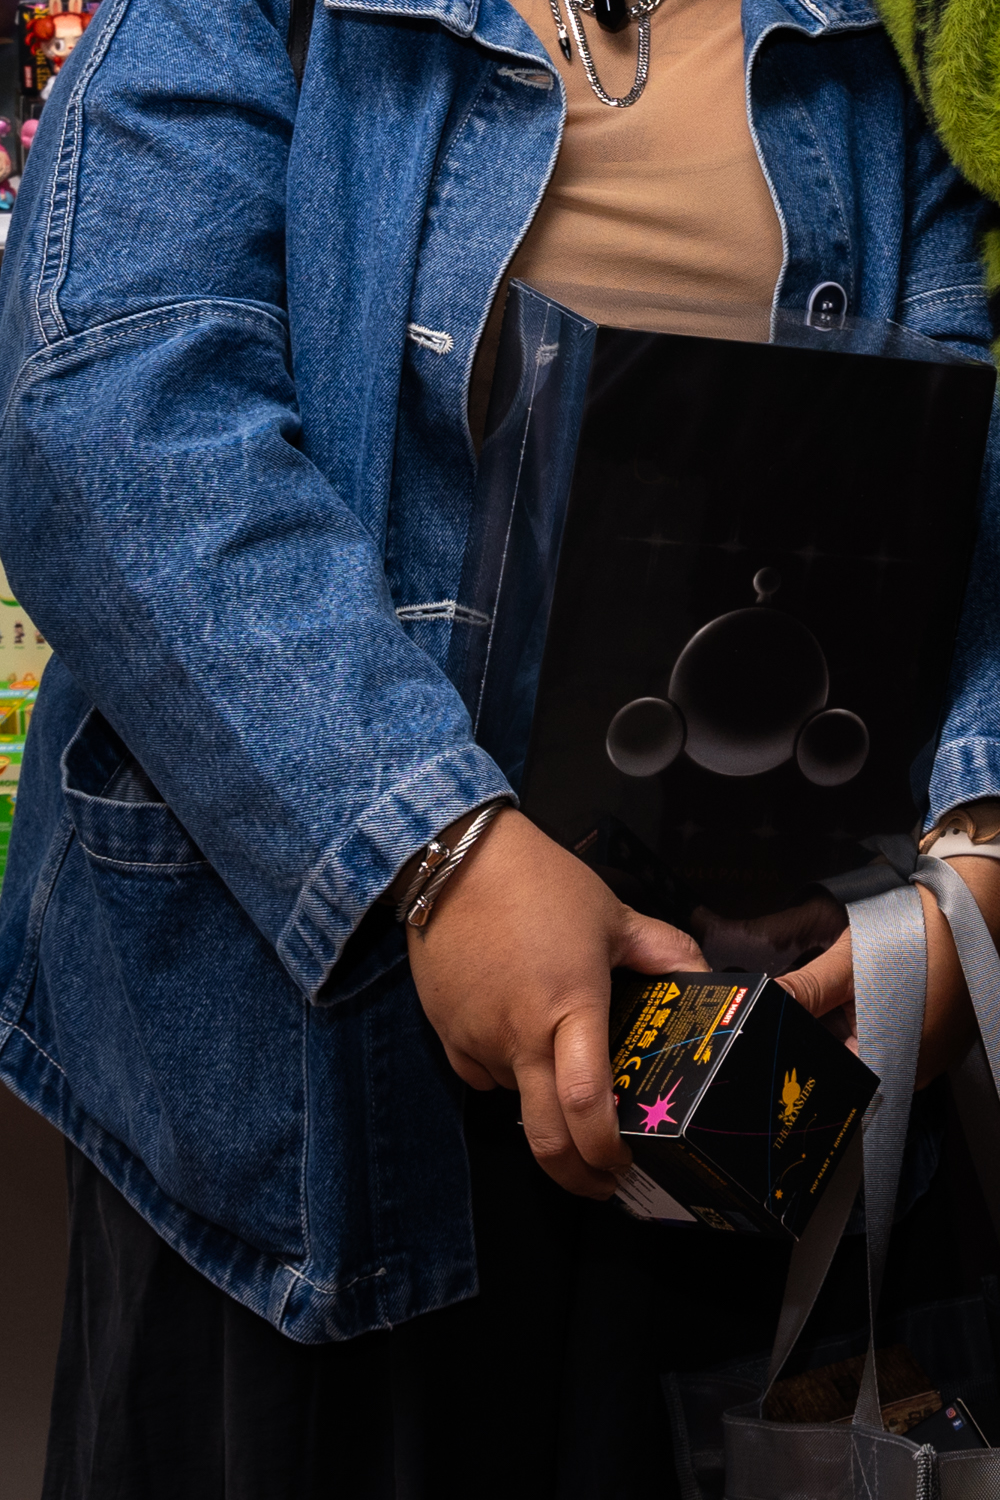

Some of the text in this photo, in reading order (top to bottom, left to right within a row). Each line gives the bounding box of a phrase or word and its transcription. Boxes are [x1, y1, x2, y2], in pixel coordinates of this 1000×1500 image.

[721, 987, 748, 1025] POP MART
[636, 1007, 671, 1049] 警告
[810, 1178, 819, 1194] POP
[817, 1158, 830, 1180] MART
